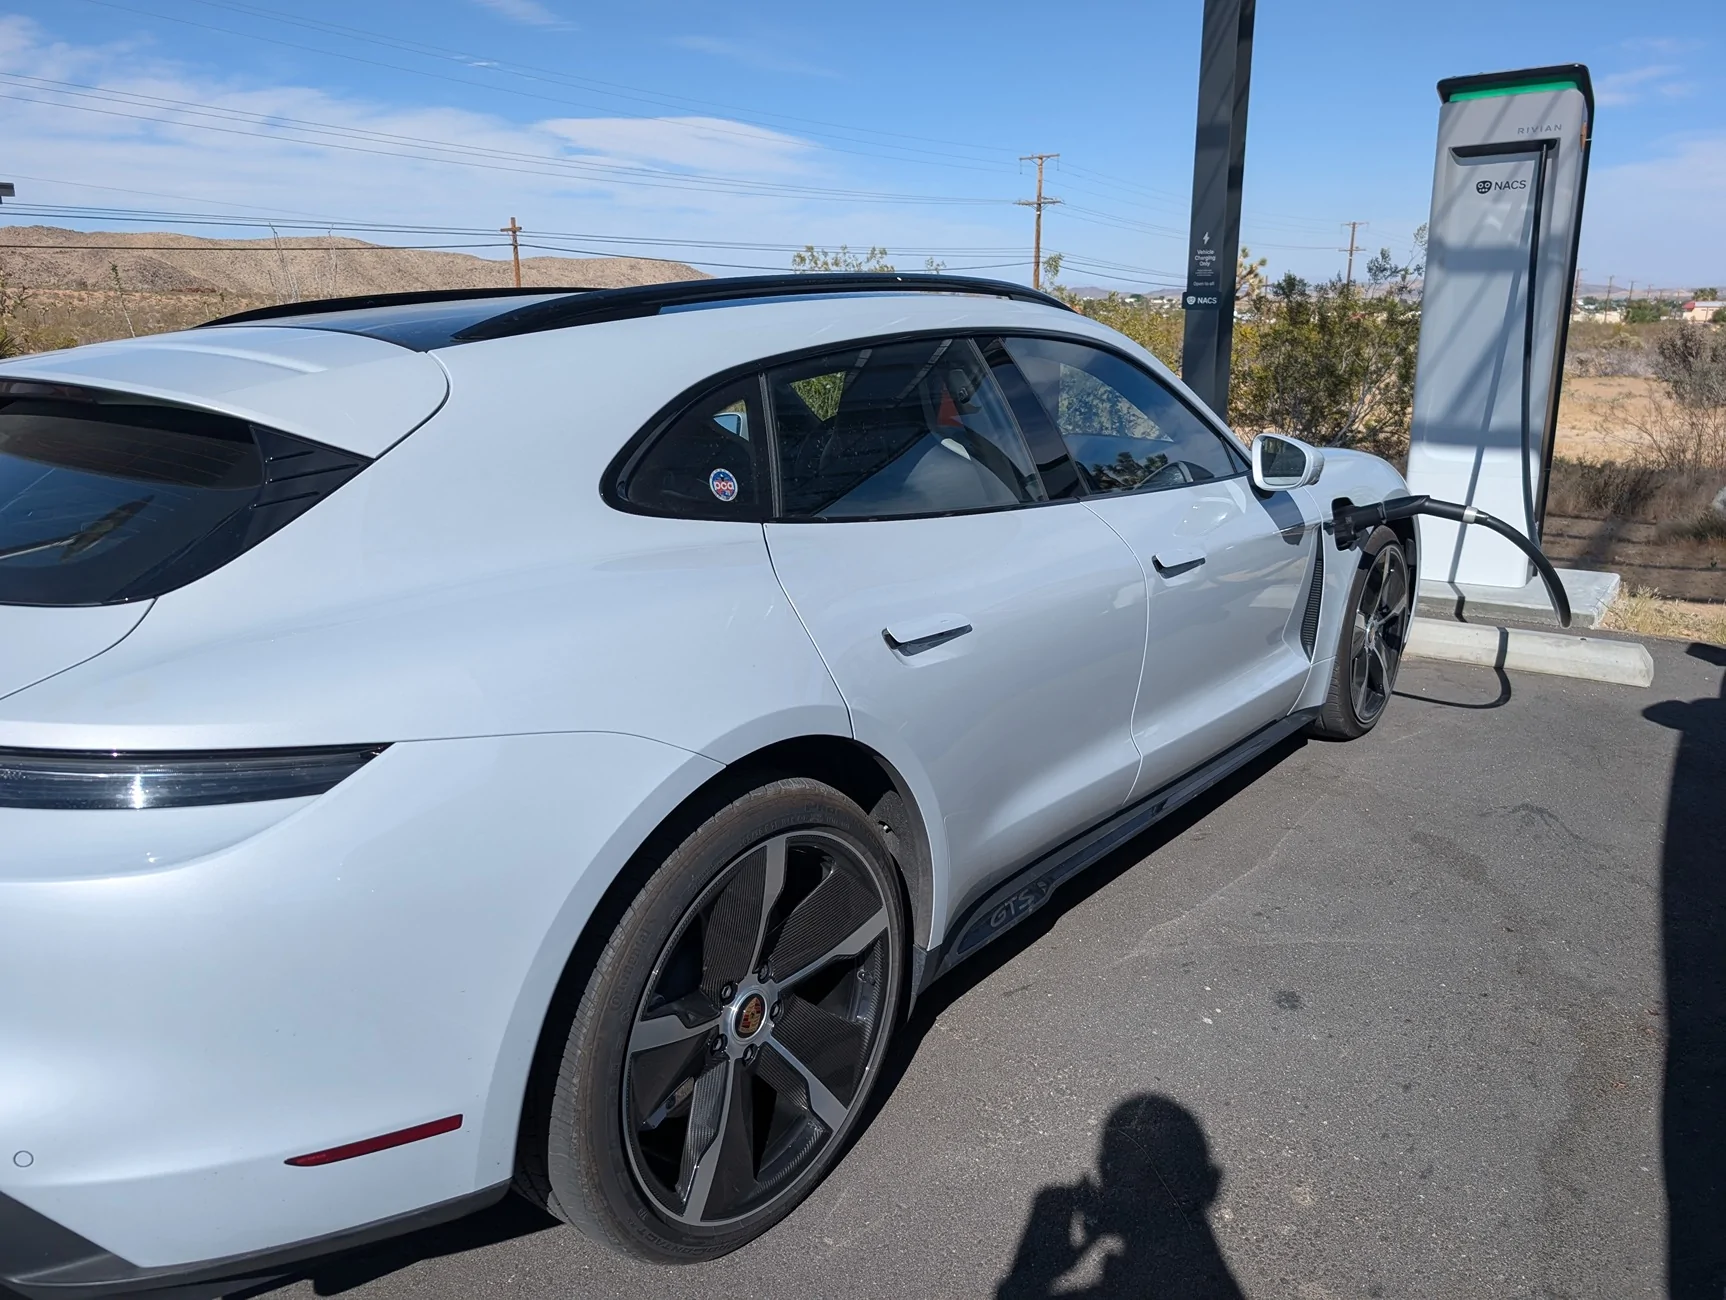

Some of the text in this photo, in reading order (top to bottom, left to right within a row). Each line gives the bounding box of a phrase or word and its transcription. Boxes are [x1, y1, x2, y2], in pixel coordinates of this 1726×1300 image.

[1517, 124, 1562, 135] RIVIAN
[1494, 180, 1527, 191] NACS
[713, 481, 735, 491] pca
[990, 889, 1035, 928] GTS
